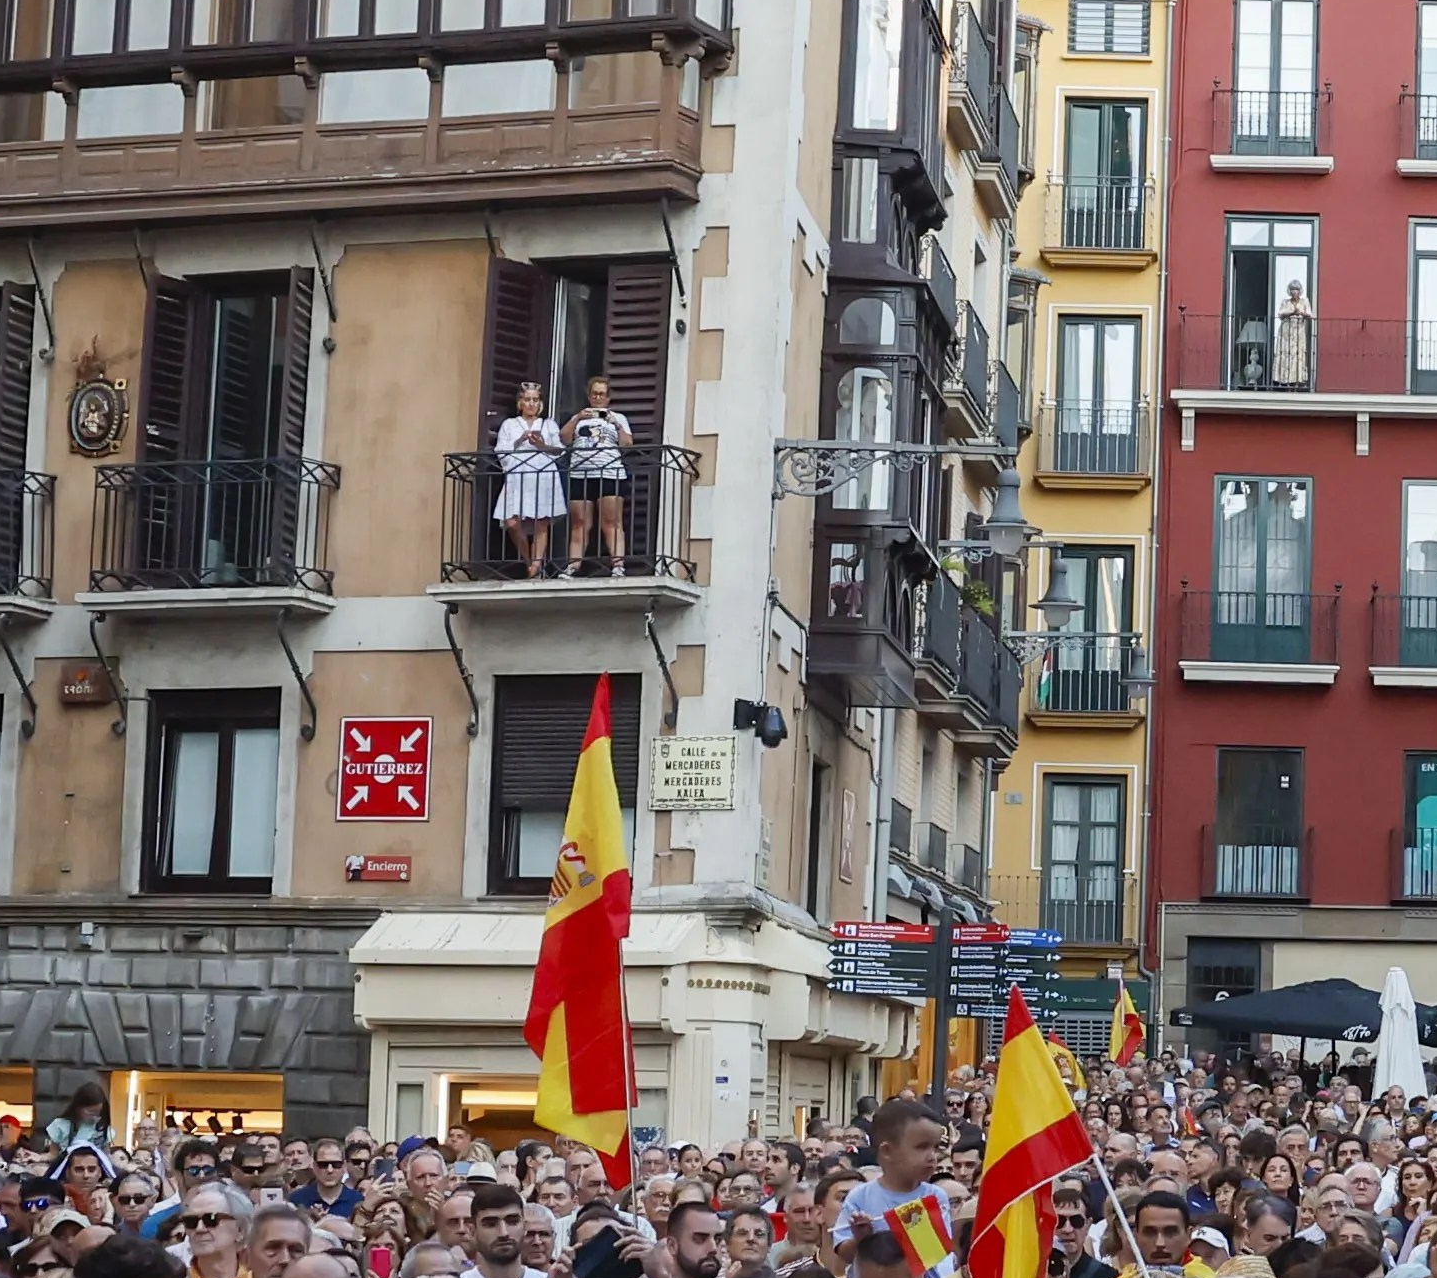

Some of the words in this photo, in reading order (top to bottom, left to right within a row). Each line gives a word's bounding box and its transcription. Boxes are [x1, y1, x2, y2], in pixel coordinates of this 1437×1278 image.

[681, 747, 706, 757] CALLE
[345, 762, 423, 775] GUTIERREZ
[665, 760, 722, 770] MERCADERES
[1421, 763, 1435, 772] EN
[664, 776, 722, 786] MERCADERES
[367, 860, 408, 871] Encierro
